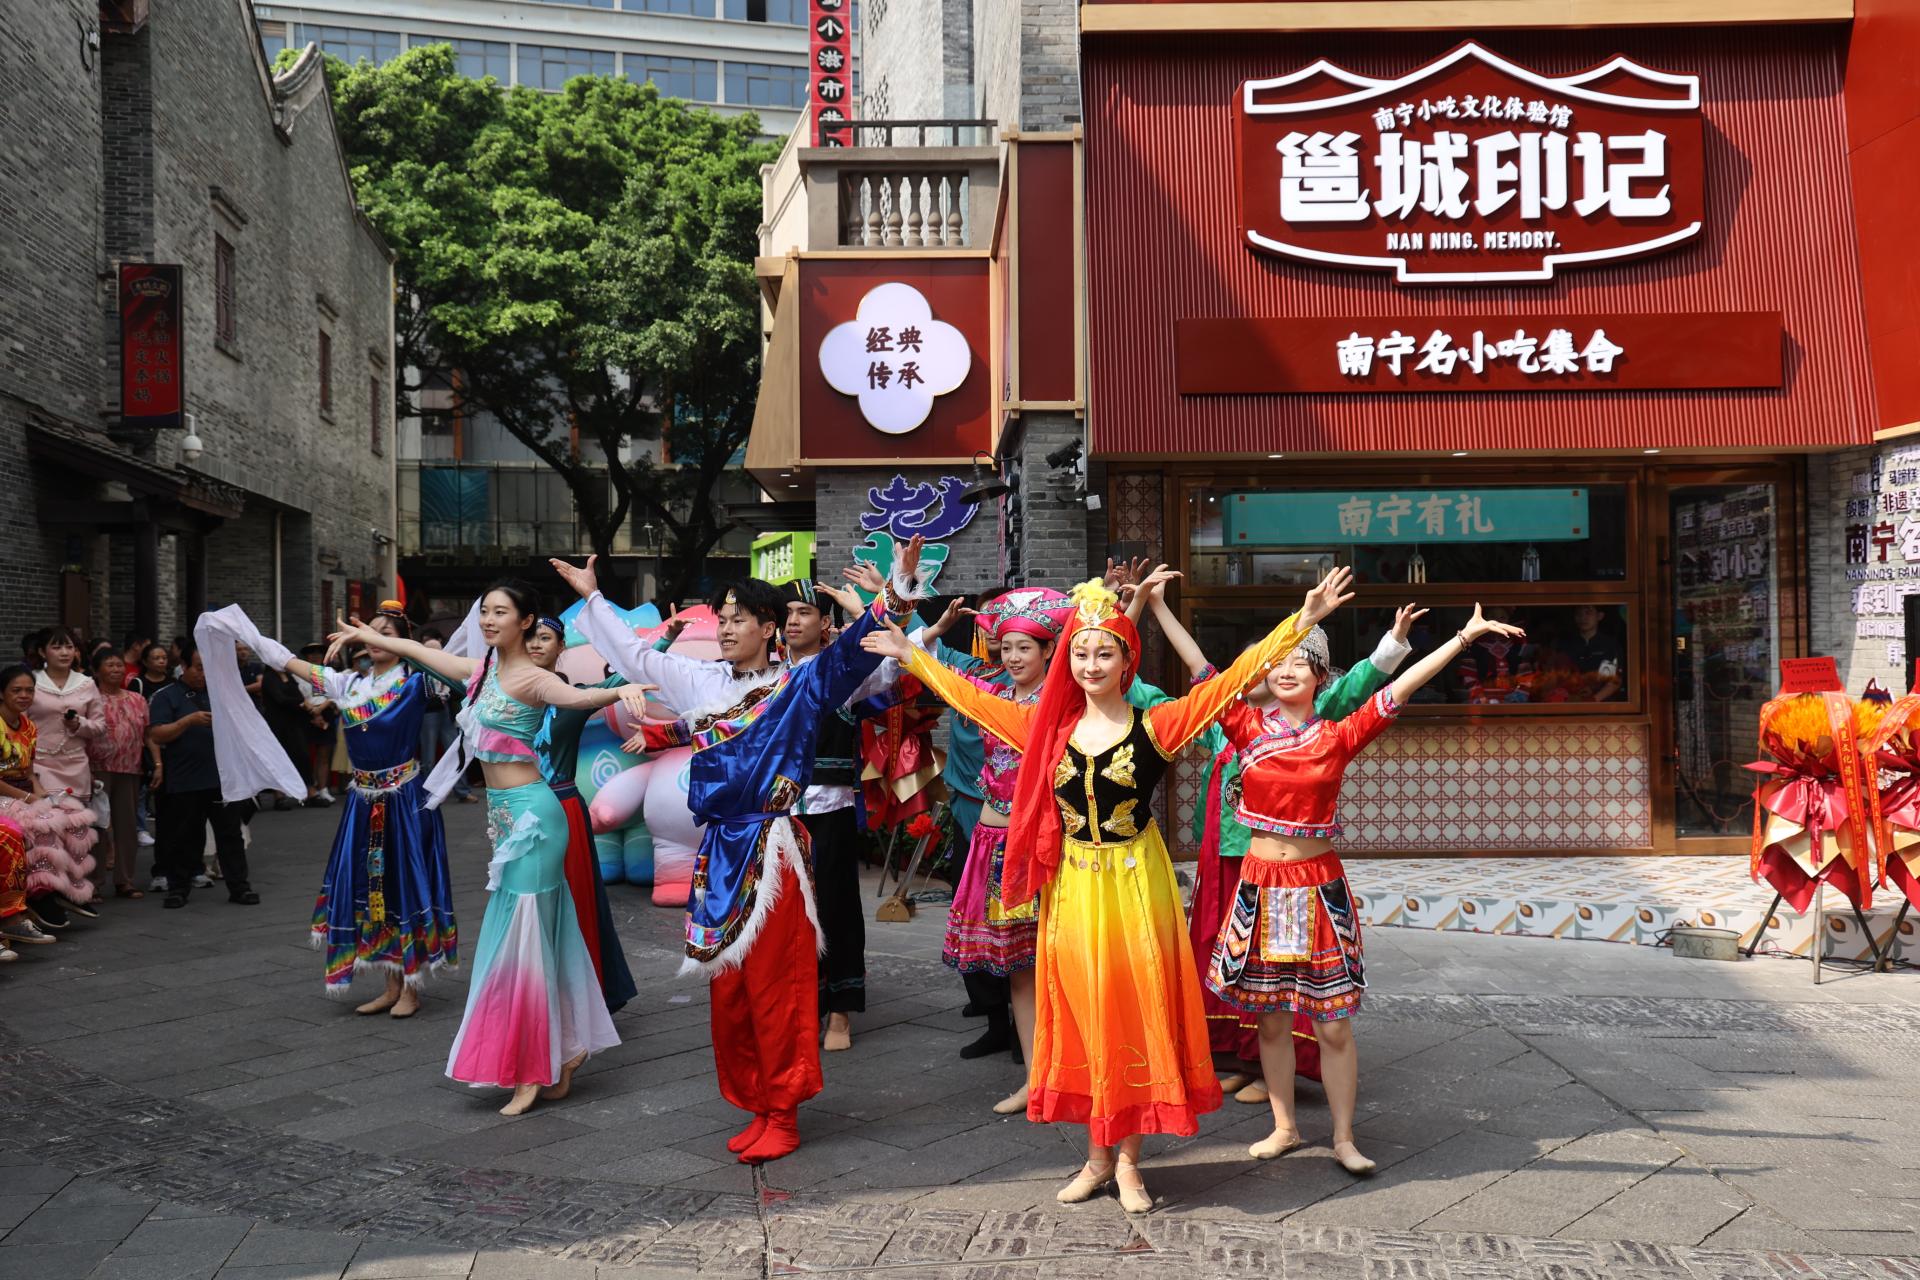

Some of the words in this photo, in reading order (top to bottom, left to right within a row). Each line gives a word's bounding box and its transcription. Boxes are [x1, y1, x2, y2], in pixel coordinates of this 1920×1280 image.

[1372, 95, 1573, 131] 南宁小吃文化体验馆
[1276, 129, 1671, 222] 邕城印记
[1387, 232, 1423, 250] NAN
[1484, 230, 1561, 249] MEMORY.
[865, 326, 924, 354] 经典
[1337, 329, 1624, 377] 南宁名小吃集合
[867, 361, 925, 390] 传承
[1338, 494, 1494, 537] 南宁有礼
